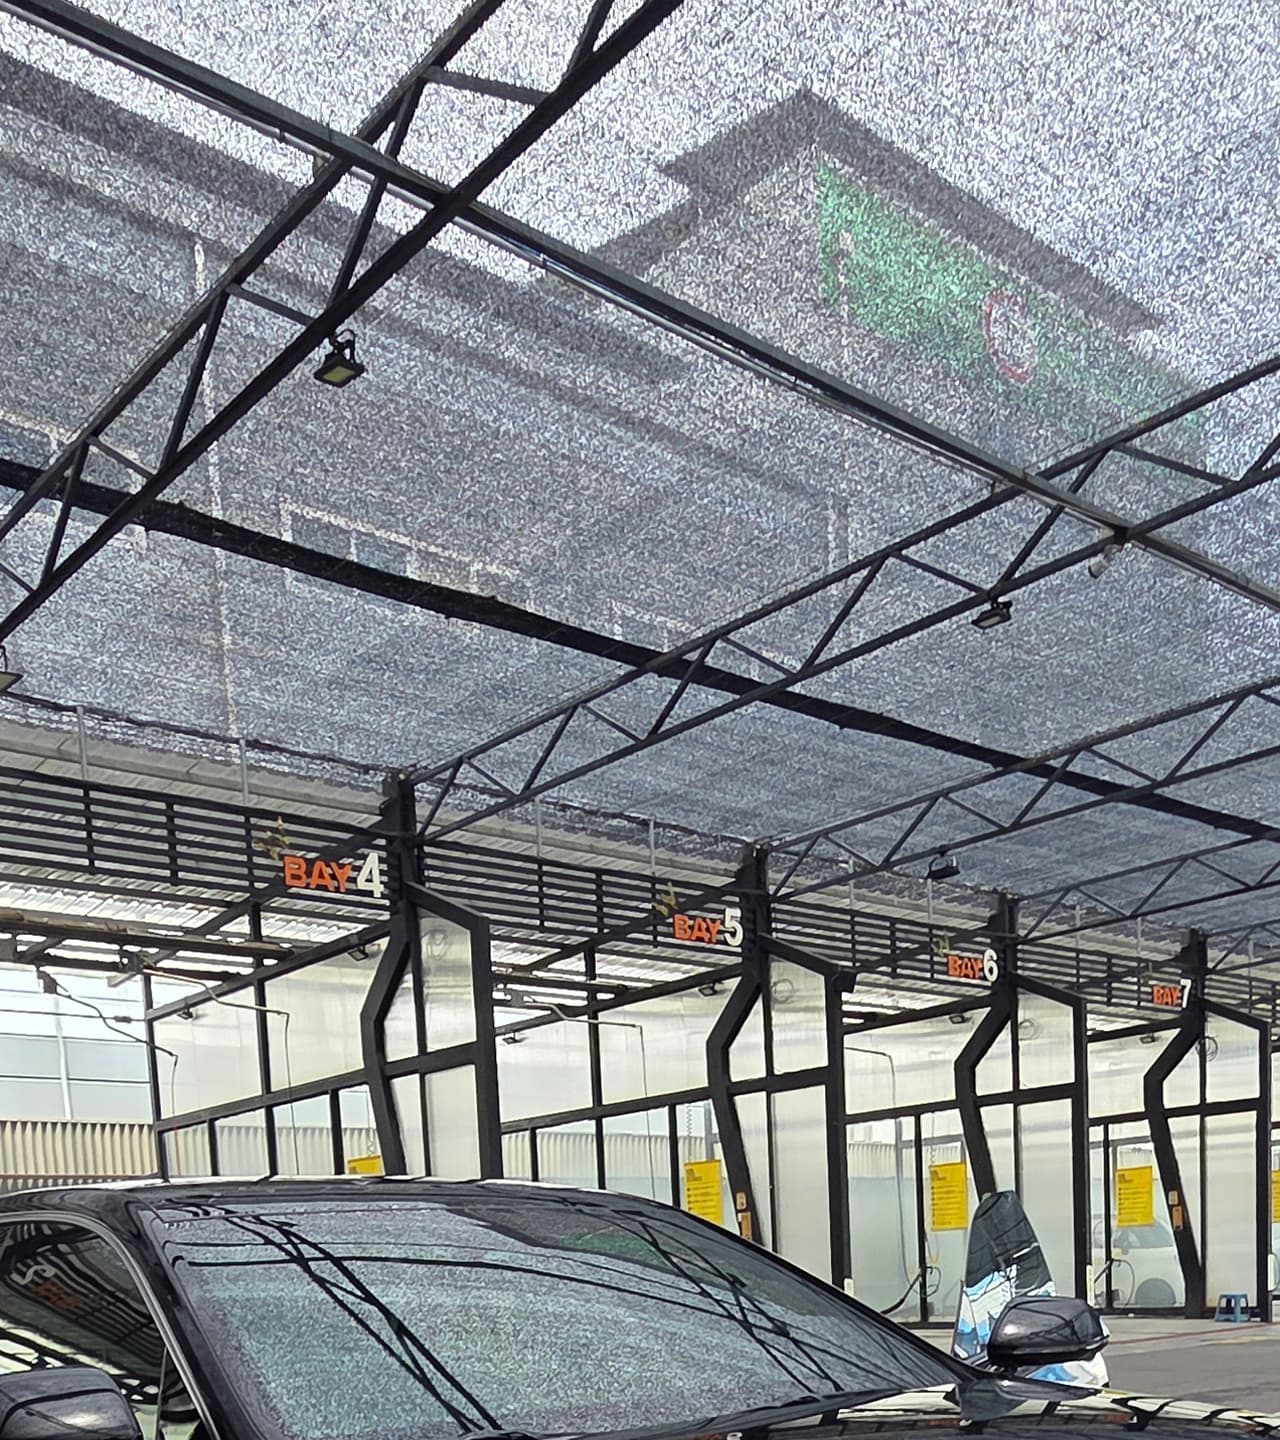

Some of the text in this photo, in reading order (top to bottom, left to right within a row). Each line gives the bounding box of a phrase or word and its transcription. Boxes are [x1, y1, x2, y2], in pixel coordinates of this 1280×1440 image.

[283, 852, 385, 898] BAY 4
[673, 907, 744, 947] BAY 5
[948, 948, 999, 983] BAY 6
[1152, 979, 1192, 1009] BAY 7
